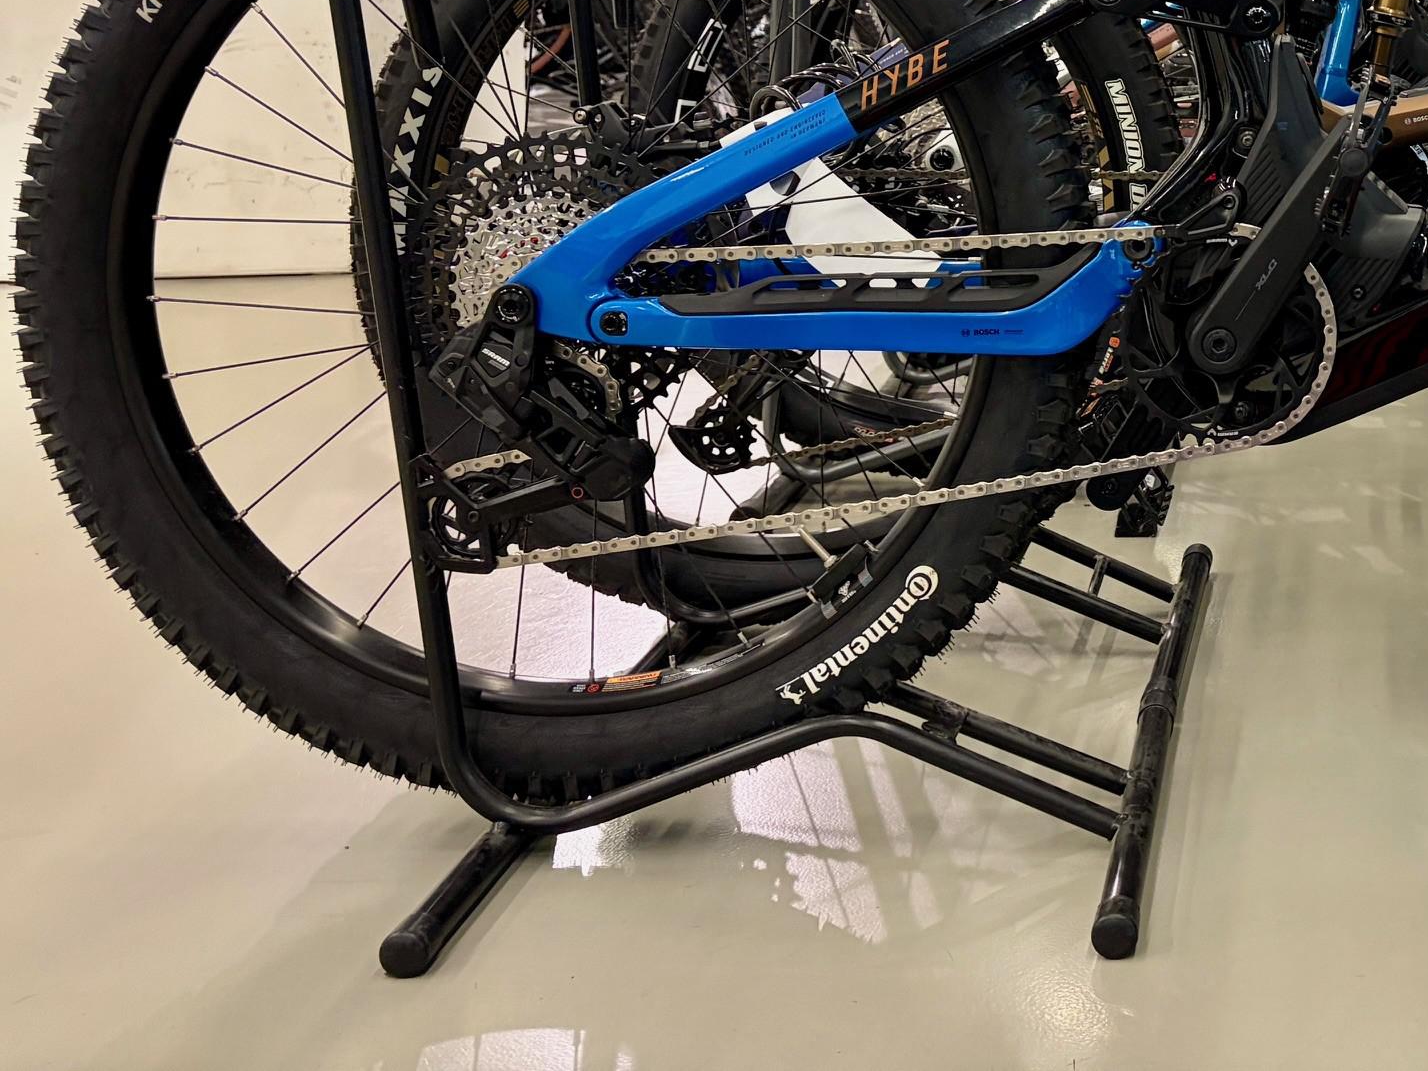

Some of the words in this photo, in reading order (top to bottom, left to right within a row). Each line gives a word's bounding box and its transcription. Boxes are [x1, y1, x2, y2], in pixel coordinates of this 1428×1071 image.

[861, 39, 950, 110] HYBE
[1105, 79, 1146, 174] MINION
[1256, 258, 1277, 290] XLC
[481, 348, 510, 367] SRAM
[974, 328, 1000, 337] BOSCH
[800, 565, 940, 695] Continental
